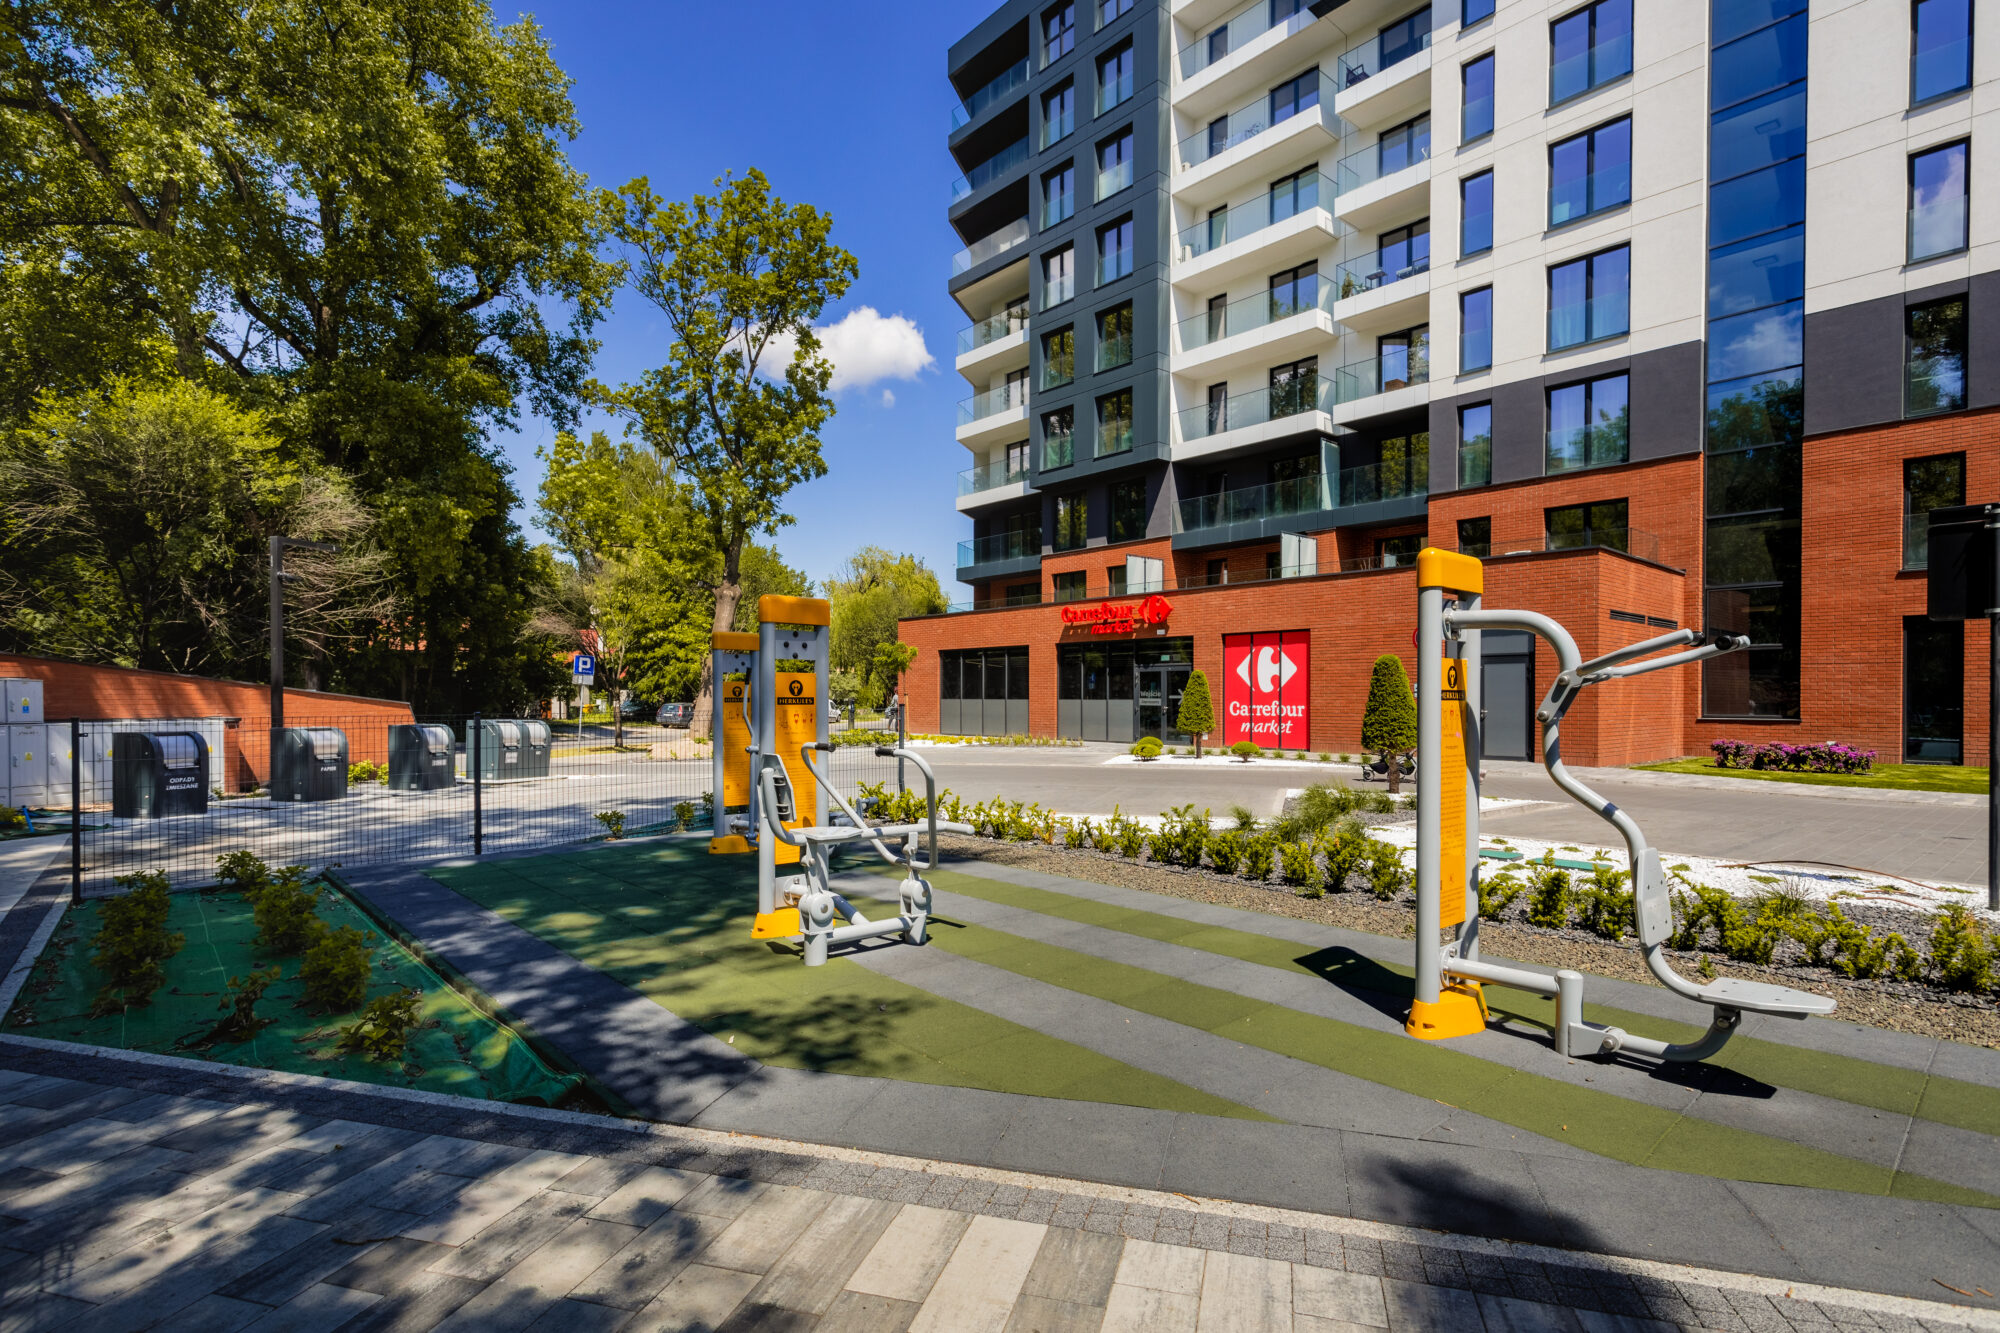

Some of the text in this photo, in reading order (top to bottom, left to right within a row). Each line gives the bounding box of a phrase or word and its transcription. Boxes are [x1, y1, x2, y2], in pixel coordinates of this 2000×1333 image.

[1061, 602, 1135, 623] Carrefour
[1091, 619, 1134, 635] market
[579, 657, 591, 672] P
[1229, 700, 1305, 717] Carrefour
[1240, 720, 1293, 735] market
